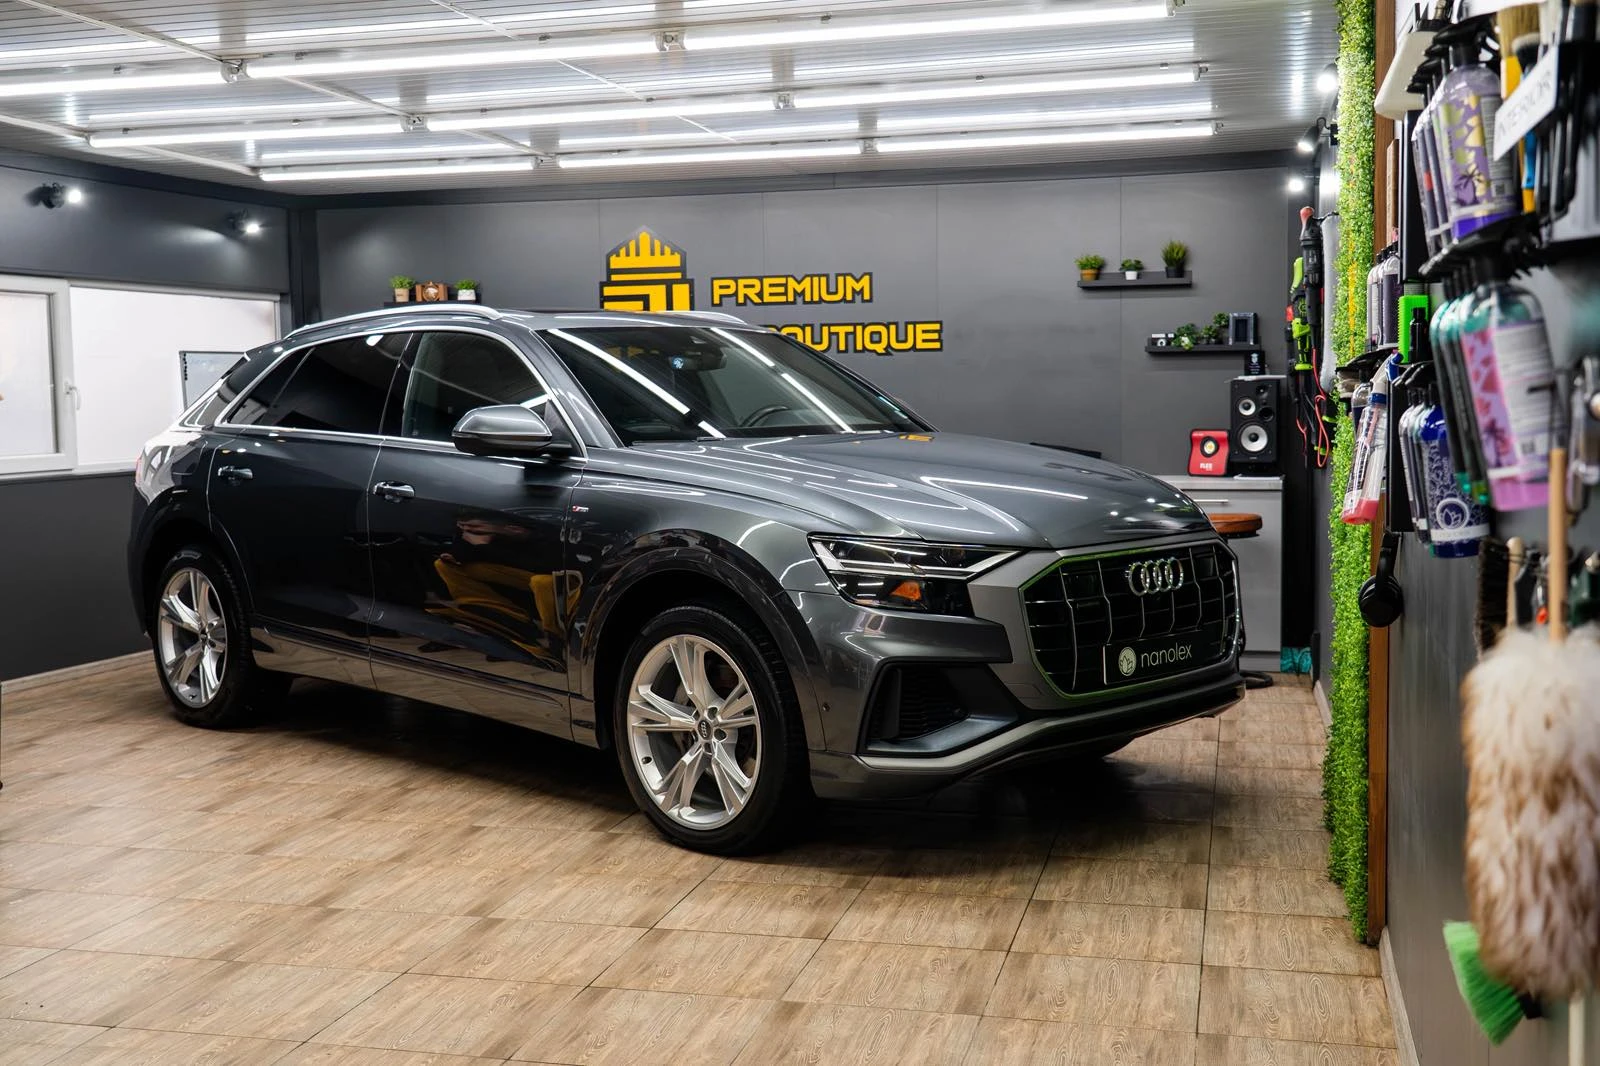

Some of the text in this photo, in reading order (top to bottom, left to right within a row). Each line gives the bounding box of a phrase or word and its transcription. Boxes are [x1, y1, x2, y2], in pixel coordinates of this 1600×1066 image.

[712, 273, 872, 305] PREMIUM
[766, 322, 942, 355] OUTIQUE
[1140, 642, 1193, 668] nanolex
